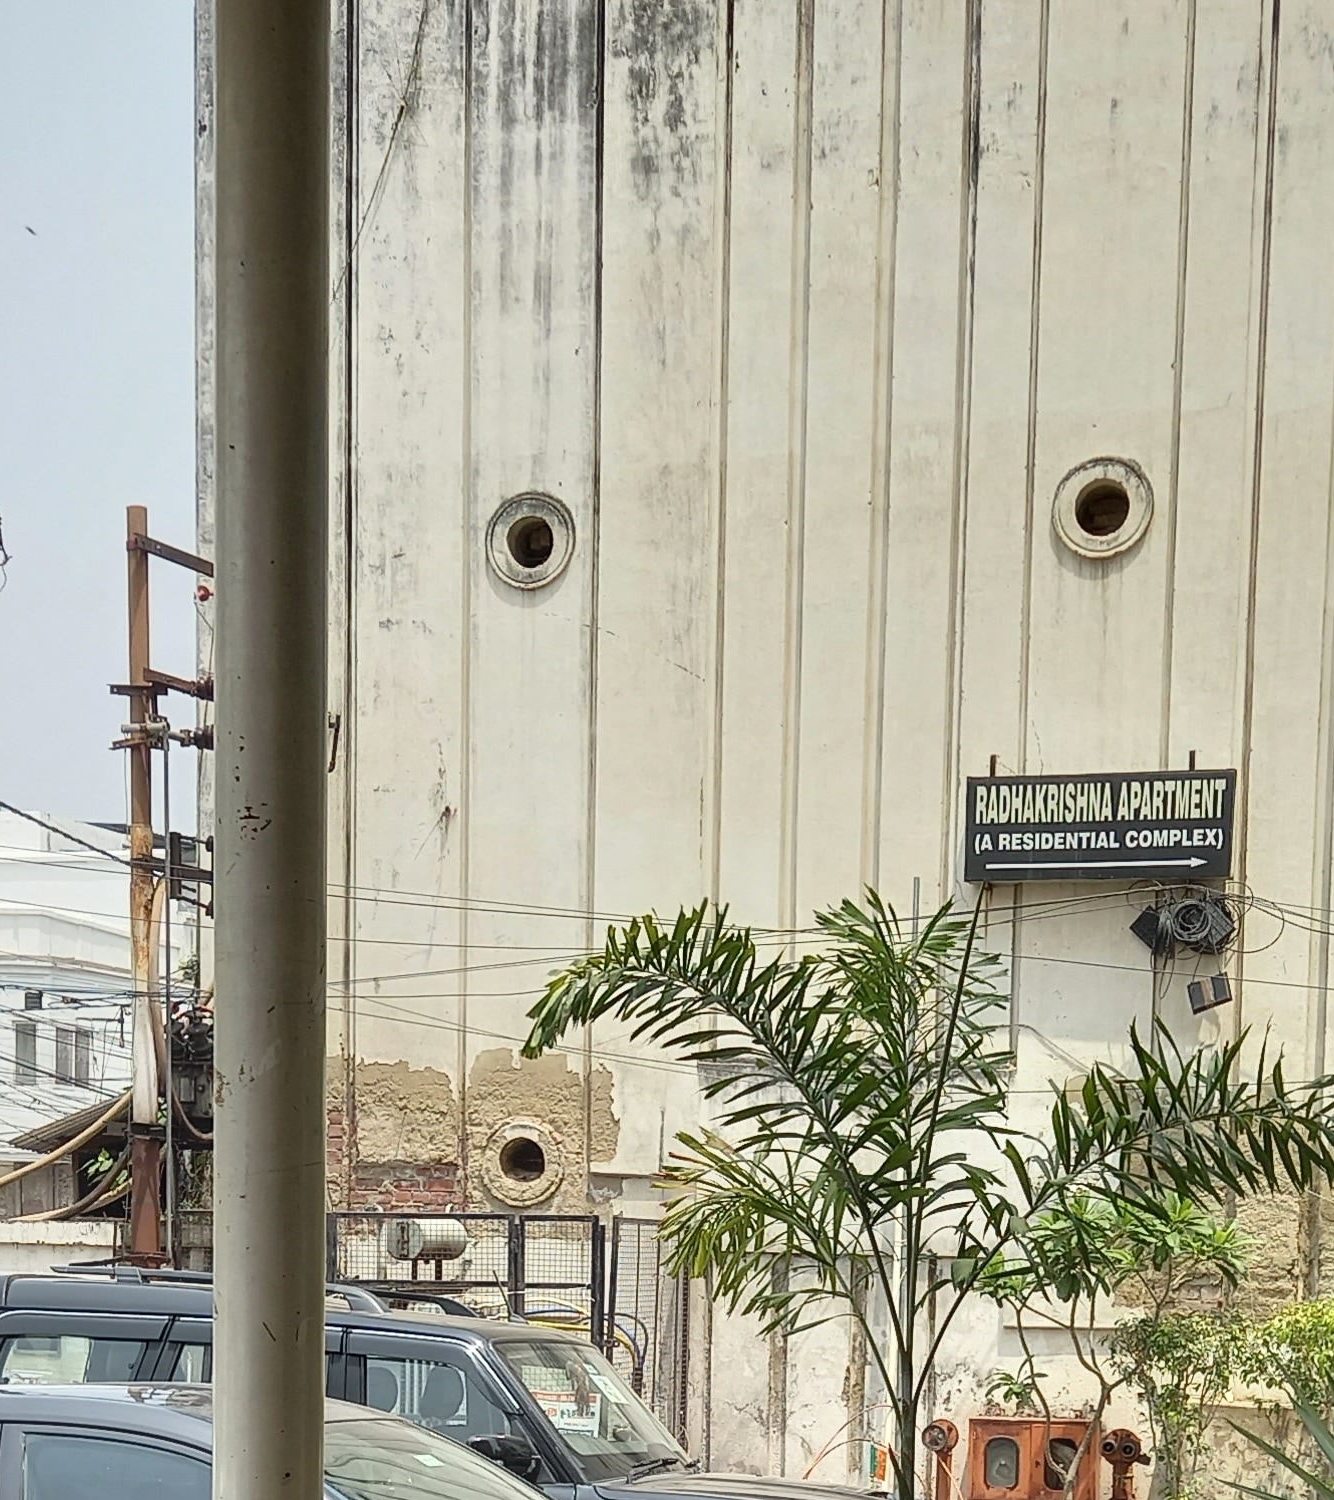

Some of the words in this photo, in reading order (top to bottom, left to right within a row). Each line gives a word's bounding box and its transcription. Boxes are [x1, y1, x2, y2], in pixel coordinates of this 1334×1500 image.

[975, 781, 1113, 825] RADHAKRISHNA
[1117, 778, 1227, 821] APARTMENT
[974, 832, 994, 855] (A
[998, 831, 1120, 850] RESIDENTIAL
[1125, 828, 1224, 850] COMPLEX)
